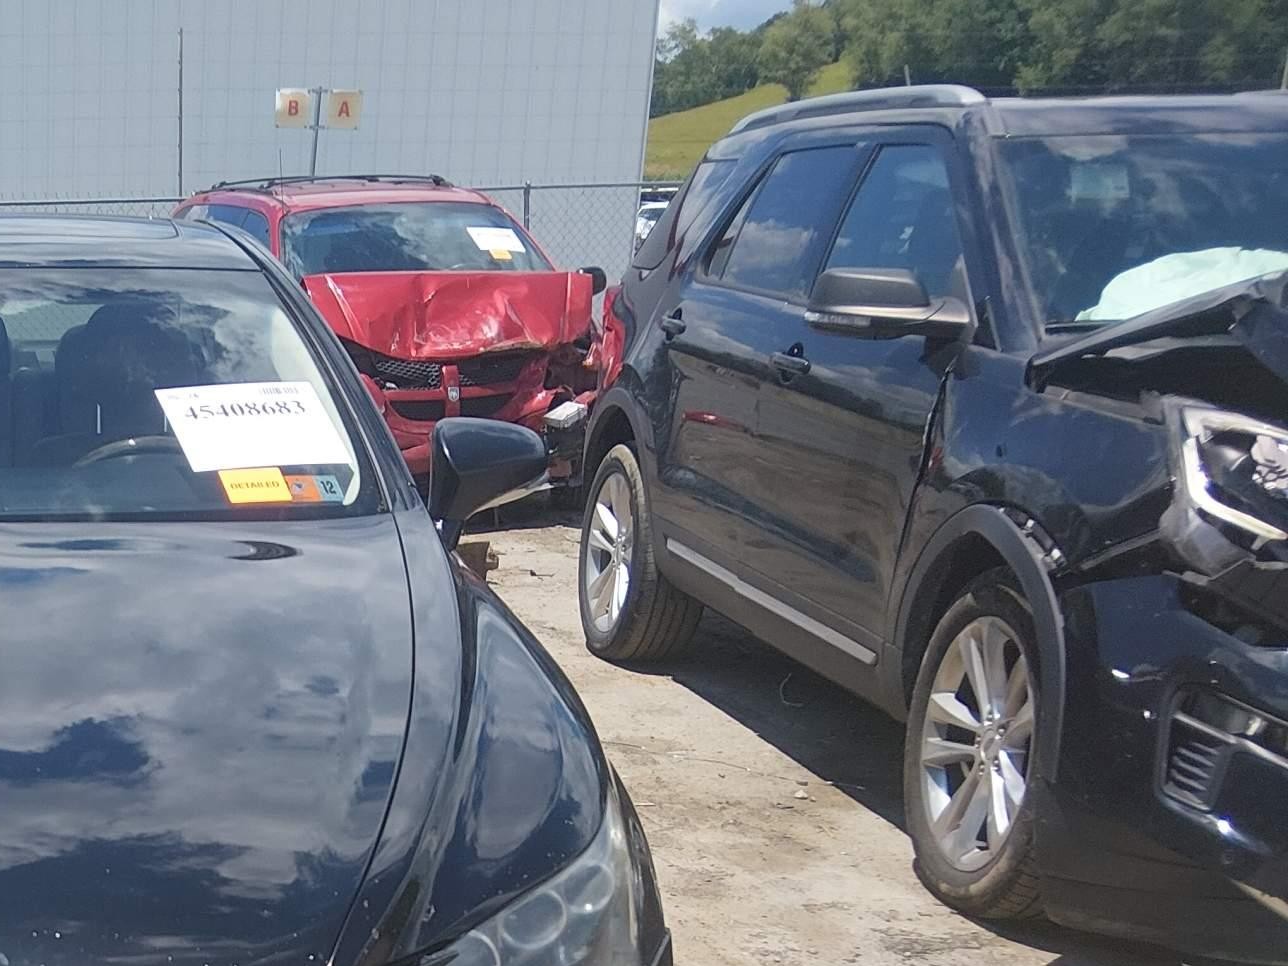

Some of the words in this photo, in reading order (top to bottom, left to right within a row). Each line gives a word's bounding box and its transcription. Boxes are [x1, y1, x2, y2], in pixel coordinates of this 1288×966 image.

[288, 100, 298, 116] B
[338, 101, 350, 117] A
[185, 401, 306, 419] 45408683
[320, 480, 337, 495] 12
